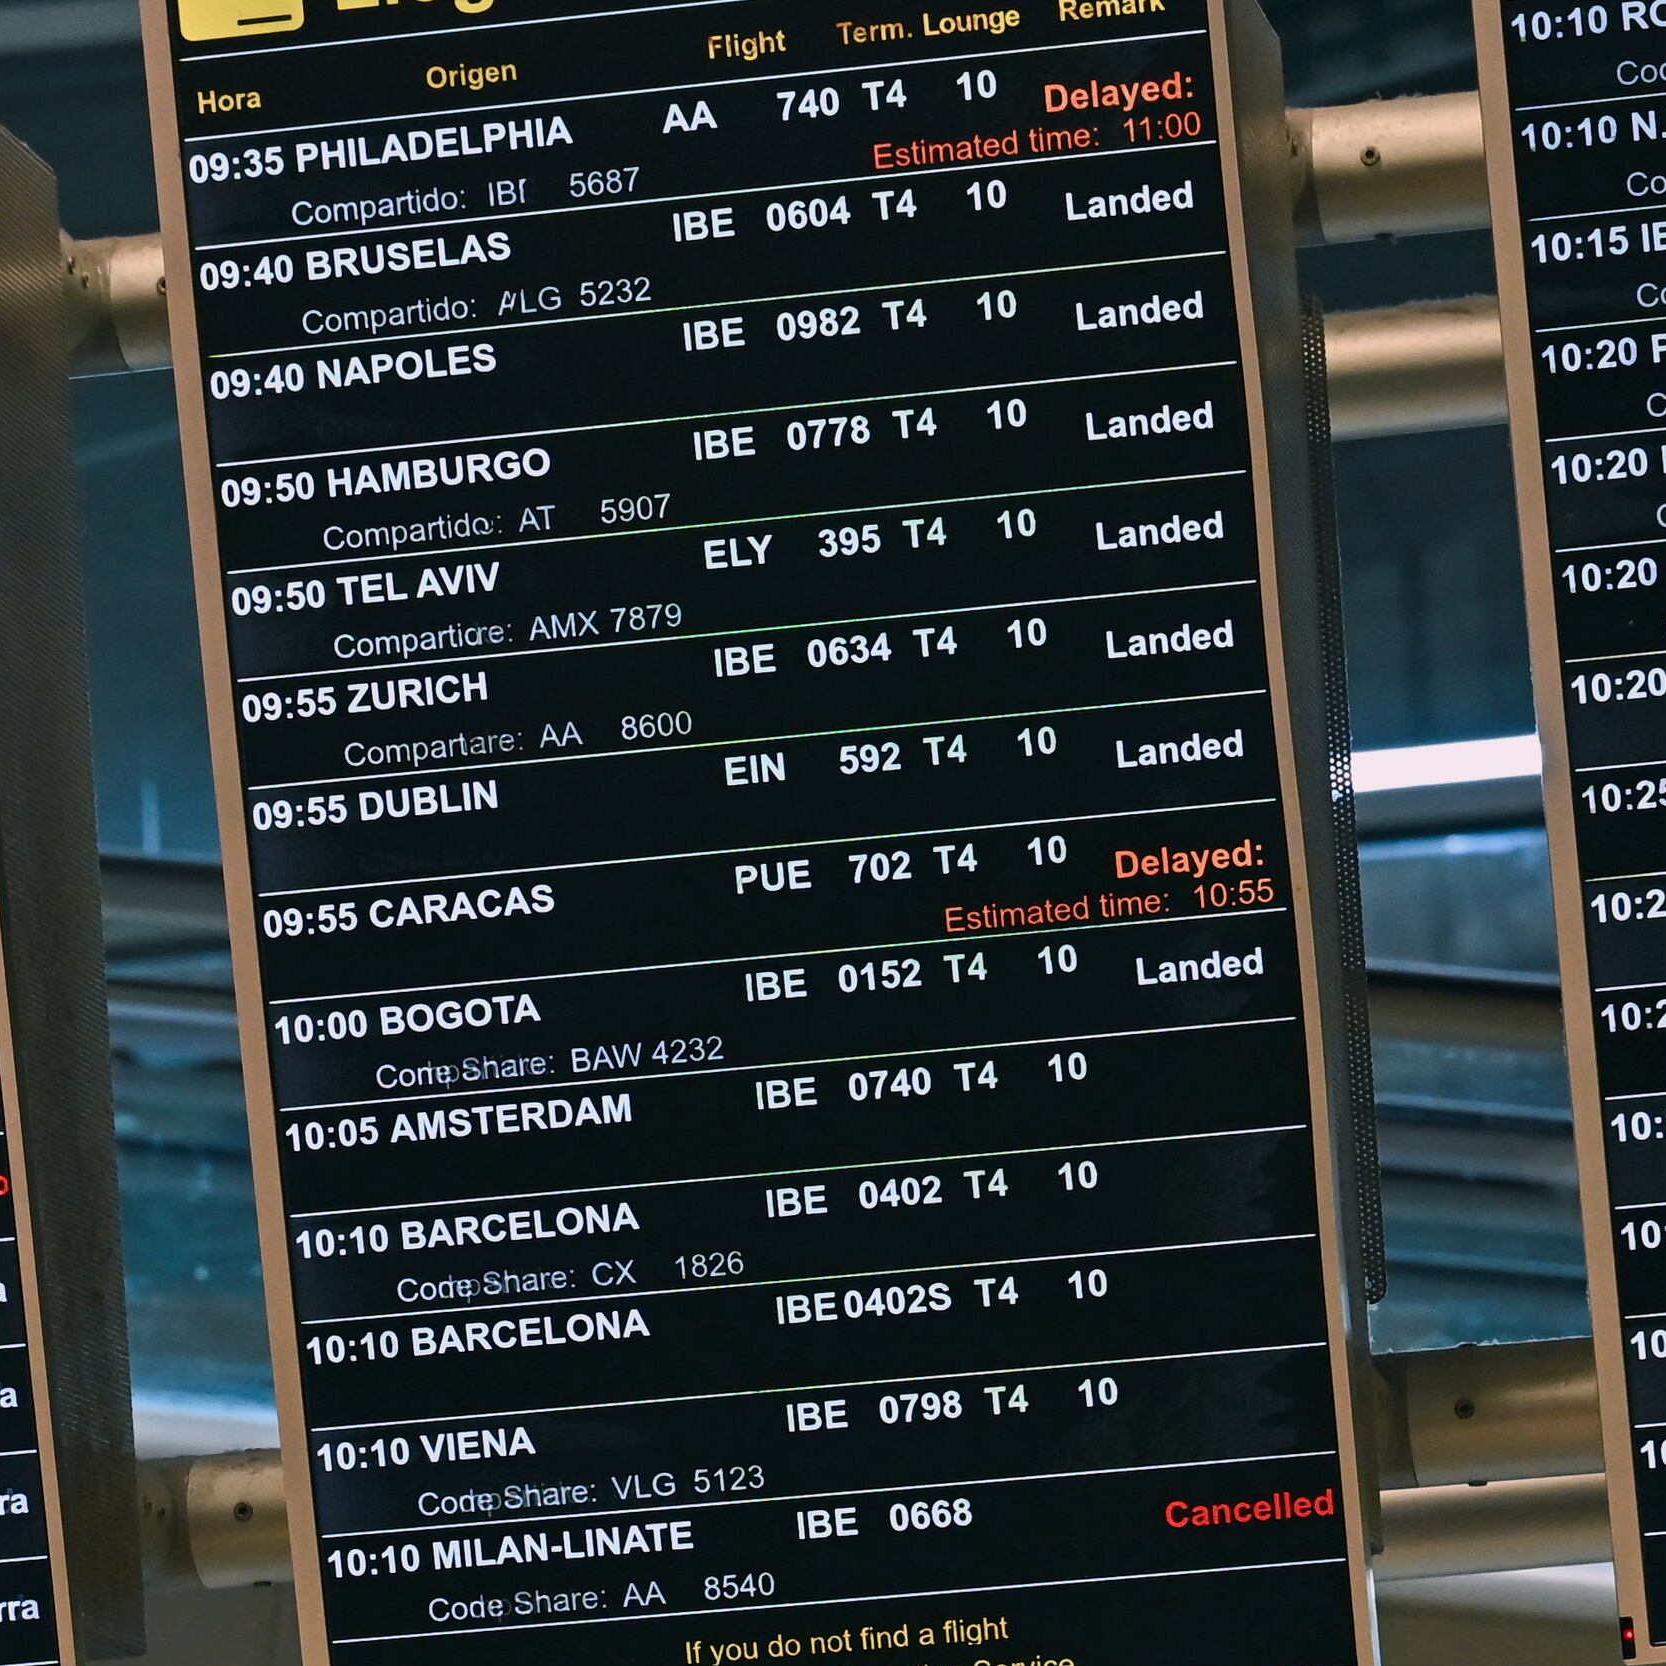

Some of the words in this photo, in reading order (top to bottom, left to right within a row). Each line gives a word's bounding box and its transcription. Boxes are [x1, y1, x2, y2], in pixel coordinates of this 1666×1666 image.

[197, 90, 262, 115] Hora
[426, 63, 518, 91] Origen
[707, 29, 787, 61] Flight
[836, 21, 914, 45] Term.
[922, 9, 1021, 37] Lounge
[188, 145, 285, 184] 09:35
[295, 115, 574, 173] PHILADELPHIA
[662, 100, 718, 134] AA
[776, 86, 840, 122] 740
[861, 78, 908, 111] T4
[956, 69, 997, 101] 10
[1044, 71, 1194, 113] Delayed:
[873, 129, 1019, 170] Estimated
[1028, 128, 1100, 153] time:
[1123, 111, 1201, 143] 11:00
[1521, 115, 1618, 152] 10:10
[1541, 336, 1638, 374] 10:20
[327, 1543, 420, 1579] 10:10
[432, 1520, 695, 1571] MILAN-LINATE
[796, 1506, 859, 1540] IBE
[889, 1497, 973, 1532] 0668
[1165, 1488, 1335, 1528] Cancelled
